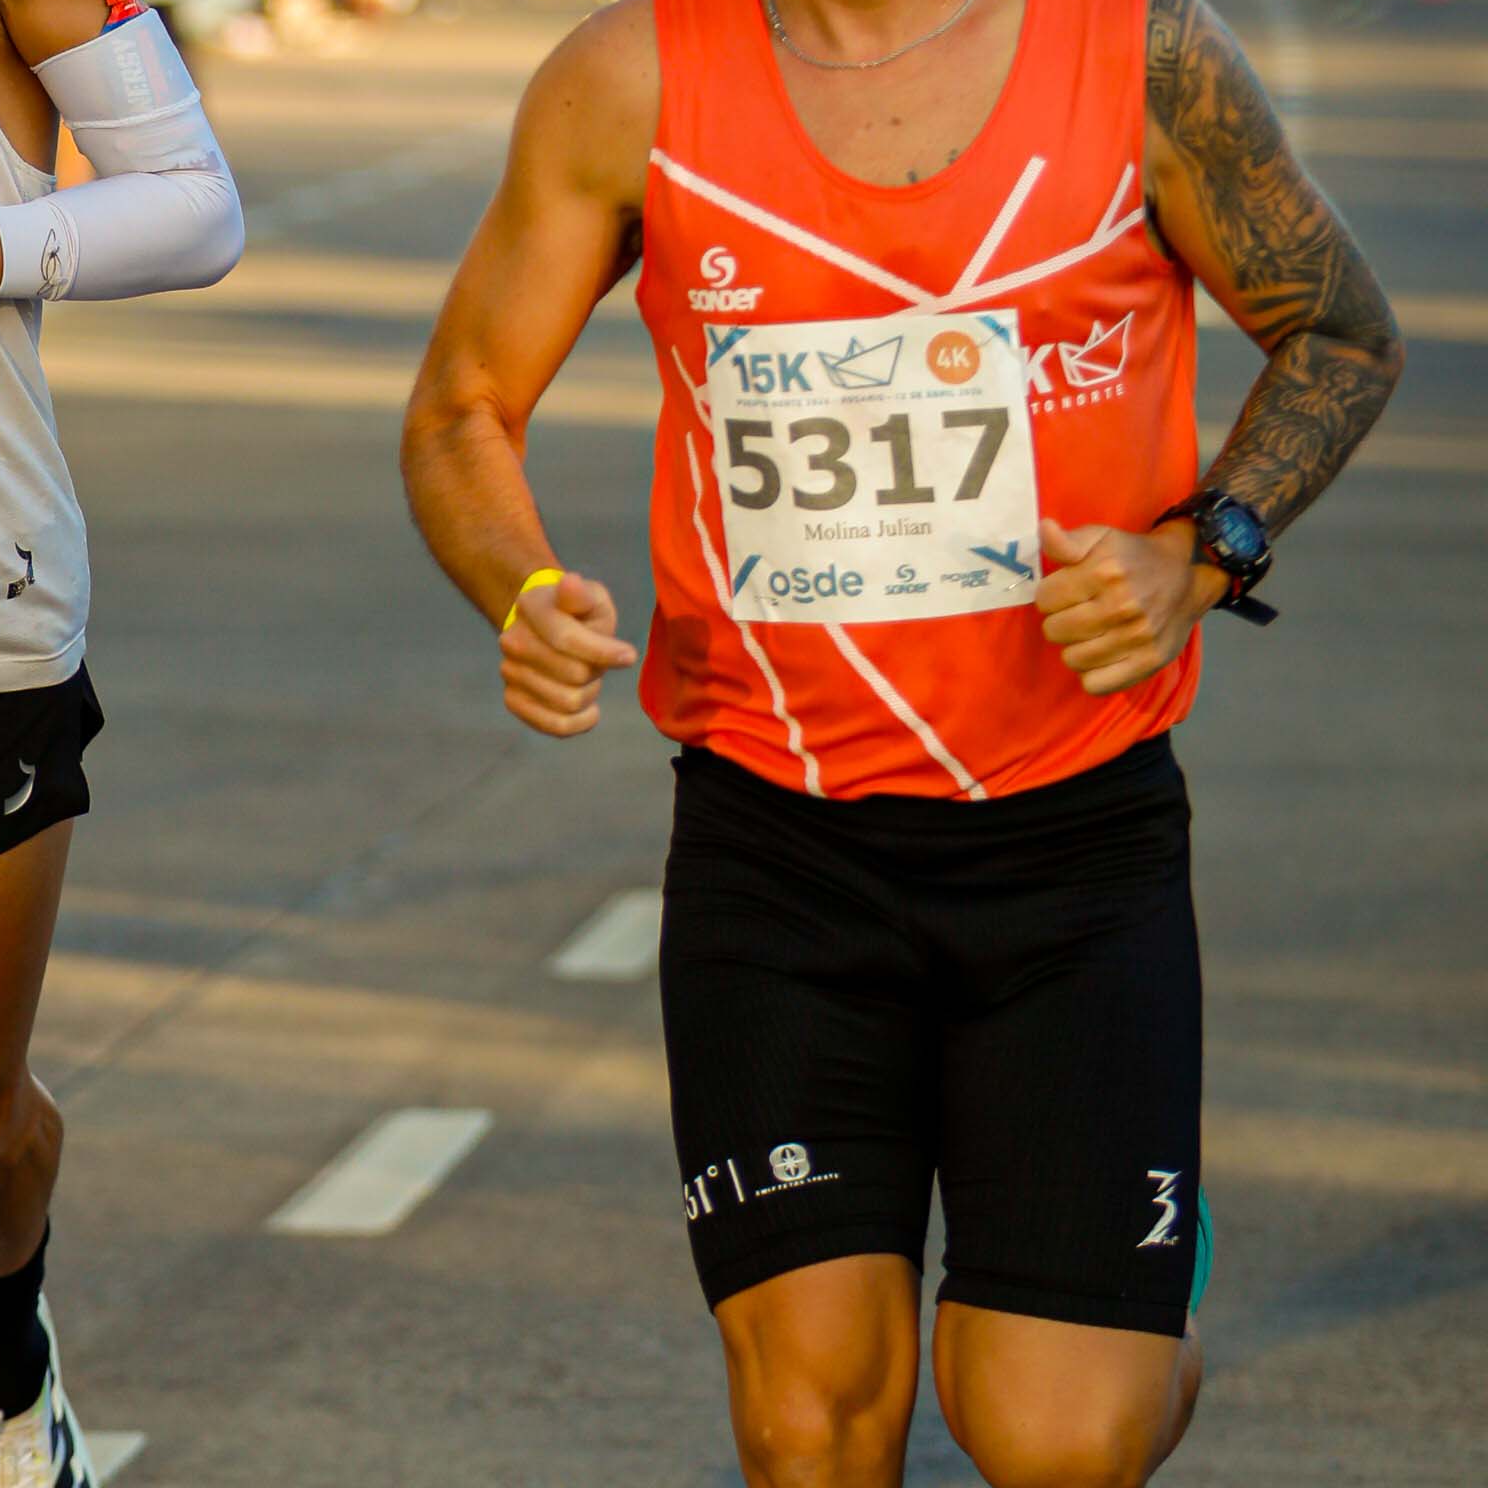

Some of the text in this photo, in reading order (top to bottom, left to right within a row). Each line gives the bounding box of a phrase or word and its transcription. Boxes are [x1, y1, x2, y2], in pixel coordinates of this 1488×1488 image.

[732, 350, 812, 393] 15K
[935, 346, 970, 370] 4K
[1019, 342, 1056, 395] K
[1030, 383, 1126, 416] TO NORTE
[725, 406, 1010, 511] 5317
[804, 518, 932, 542] Molina Julian
[769, 564, 864, 600] osde
